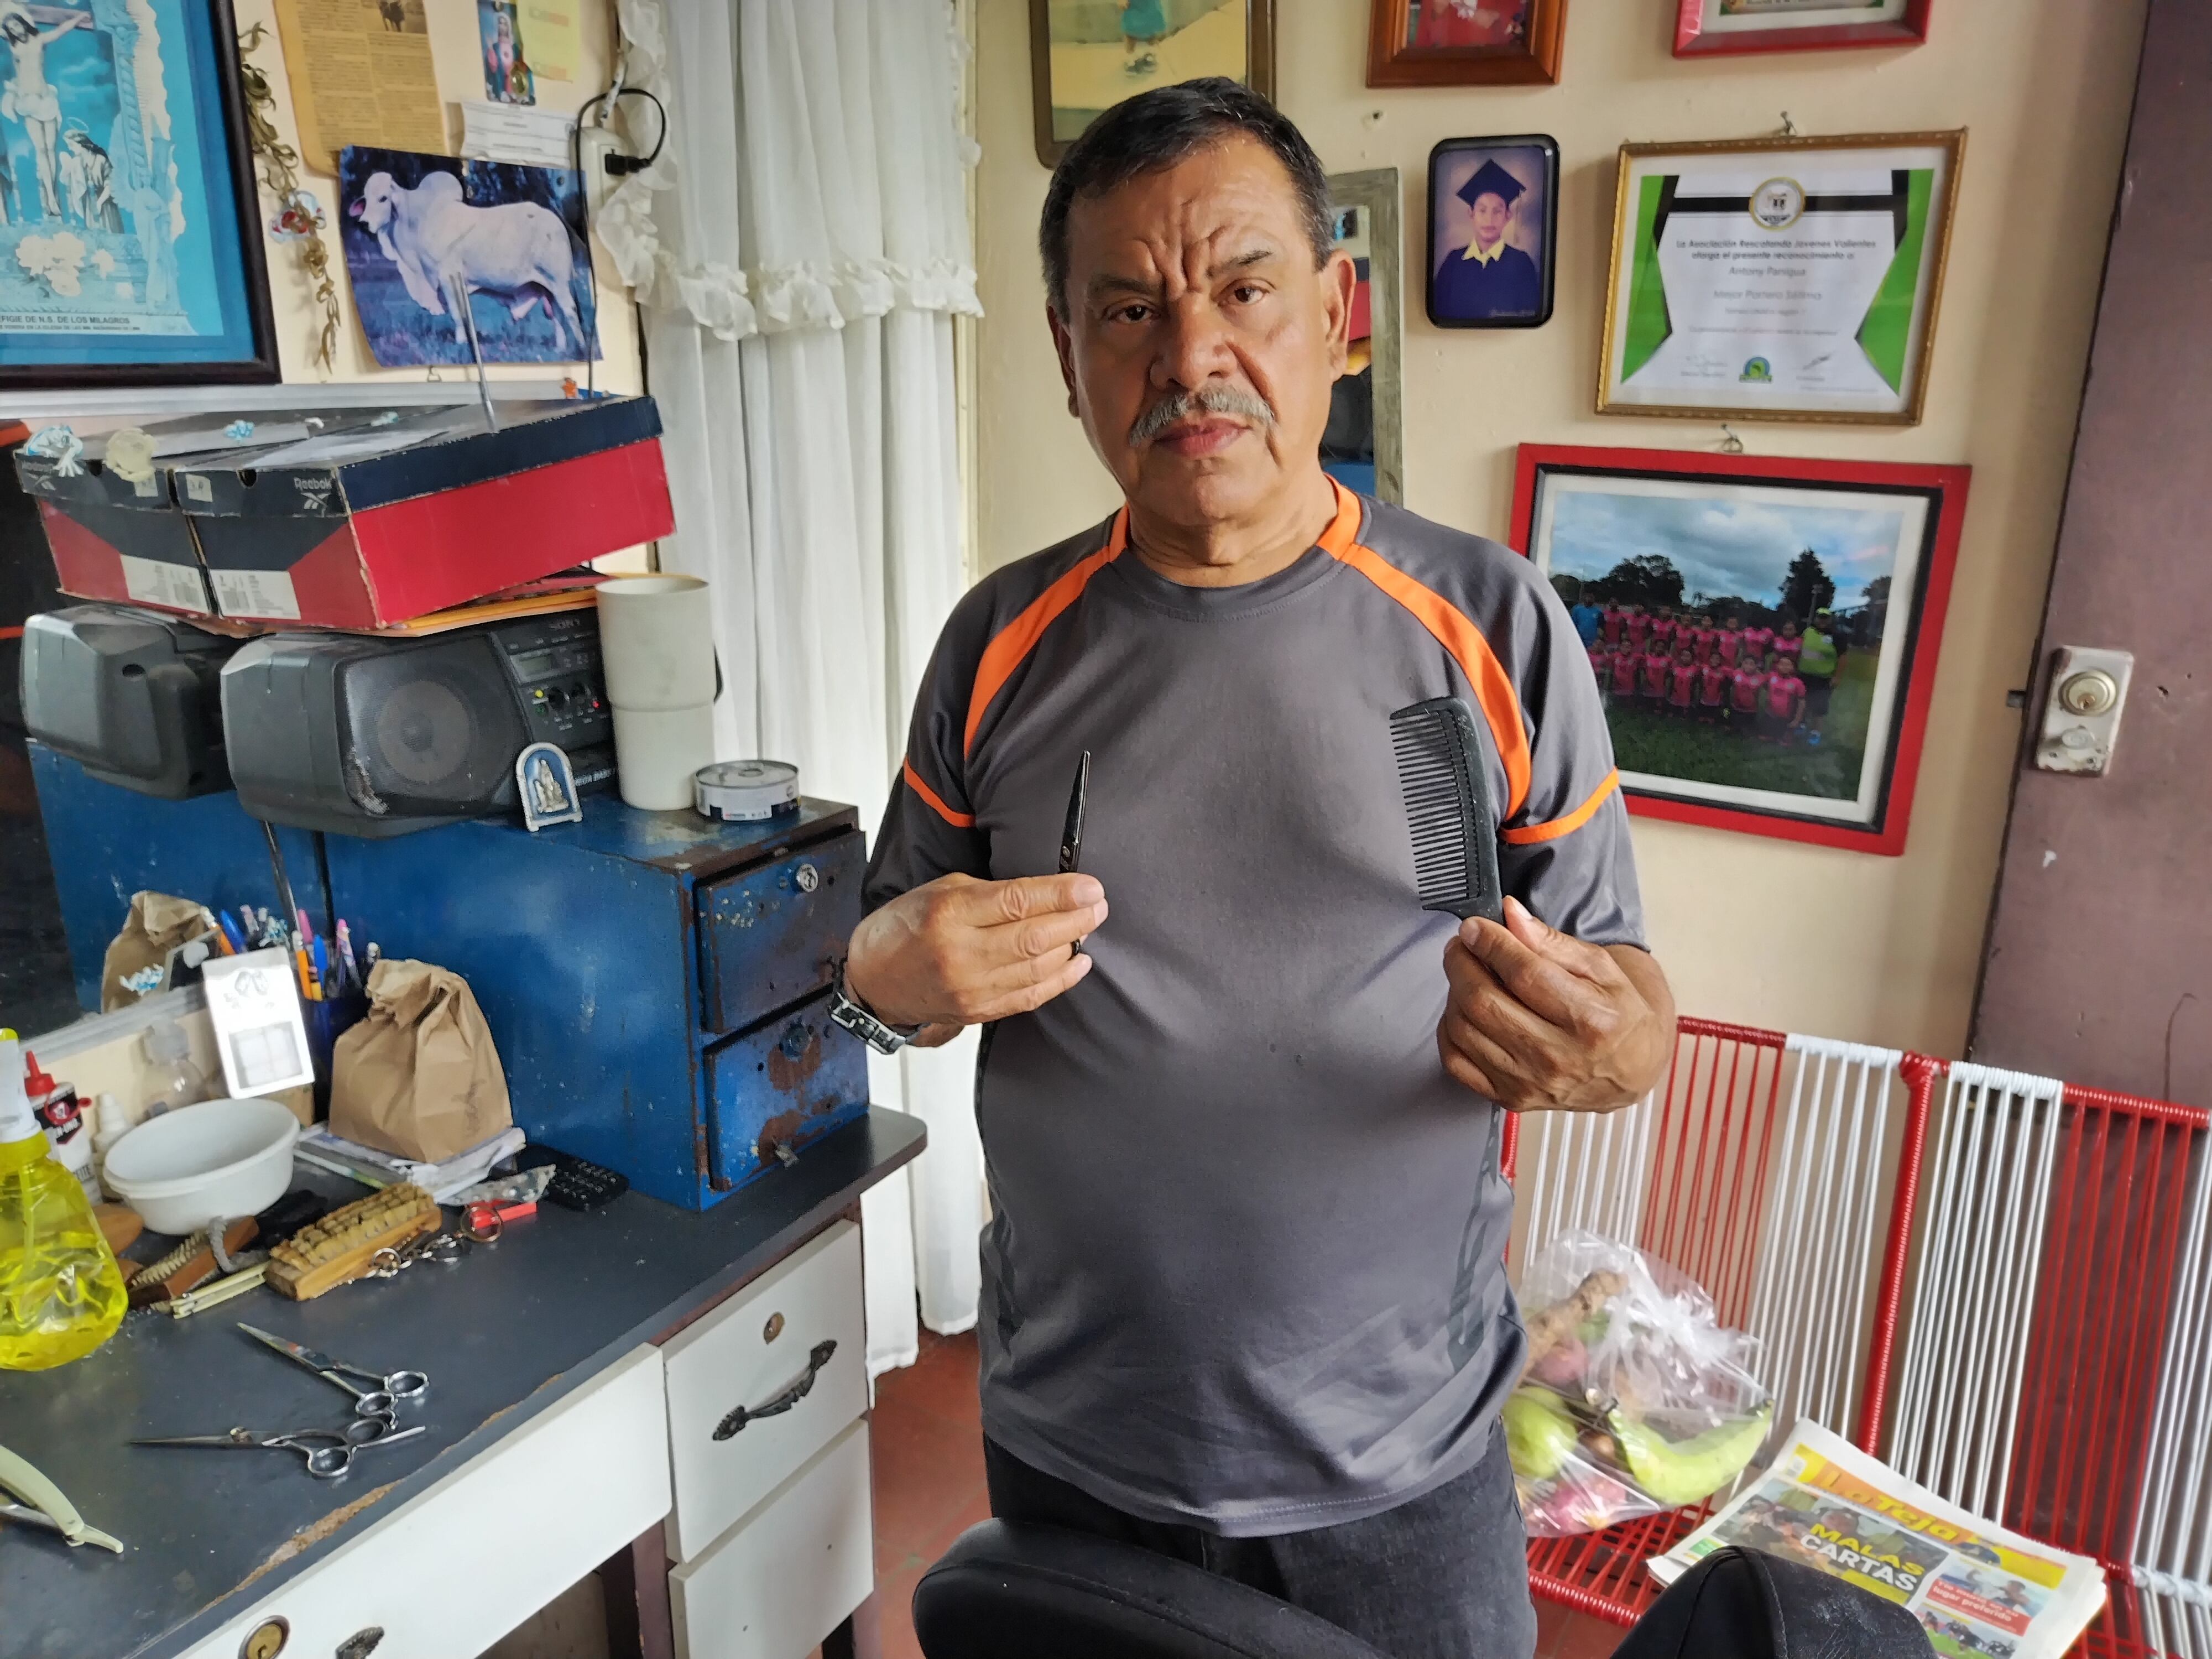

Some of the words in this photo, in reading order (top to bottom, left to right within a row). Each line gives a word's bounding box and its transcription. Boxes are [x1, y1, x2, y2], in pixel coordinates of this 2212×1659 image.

[294, 476, 332, 490] Reebok
[1875, 1494, 1959, 1542] Teja
[1800, 1535, 1917, 1591] CARTAS
[1809, 1523, 1925, 1576] MALAS
